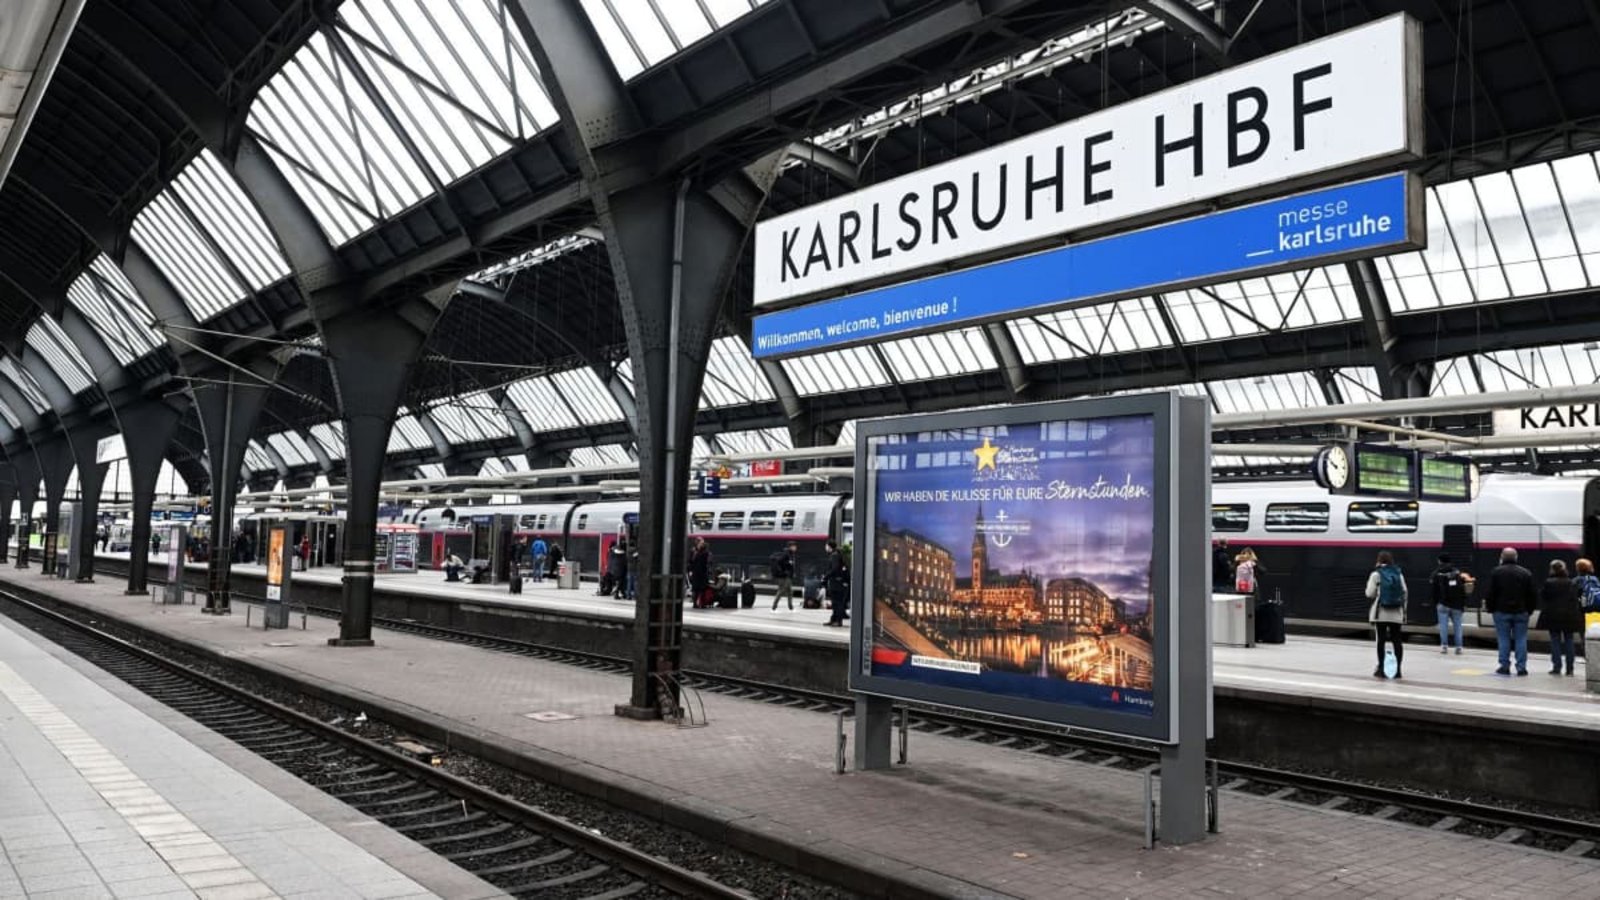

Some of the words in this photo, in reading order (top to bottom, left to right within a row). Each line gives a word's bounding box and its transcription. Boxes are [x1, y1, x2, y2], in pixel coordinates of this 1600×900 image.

[781, 130, 1113, 283] KARLSRUHE
[1155, 62, 1333, 188] HBF
[1279, 200, 1348, 227] messe
[1279, 214, 1391, 251] karlsruhe
[757, 327, 824, 350] Willkommen,
[826, 317, 880, 337] welcome,
[883, 302, 949, 326] bienvenue
[952, 297, 957, 313] !
[1520, 402, 1600, 430] KARL
[703, 476, 714, 494] E
[884, 490, 902, 502] WIR
[903, 489, 934, 502] HABEN
[935, 489, 950, 502] DIE
[951, 487, 991, 501] KULISSE
[992, 484, 1013, 500] FÜR
[1015, 486, 1043, 500] EURE
